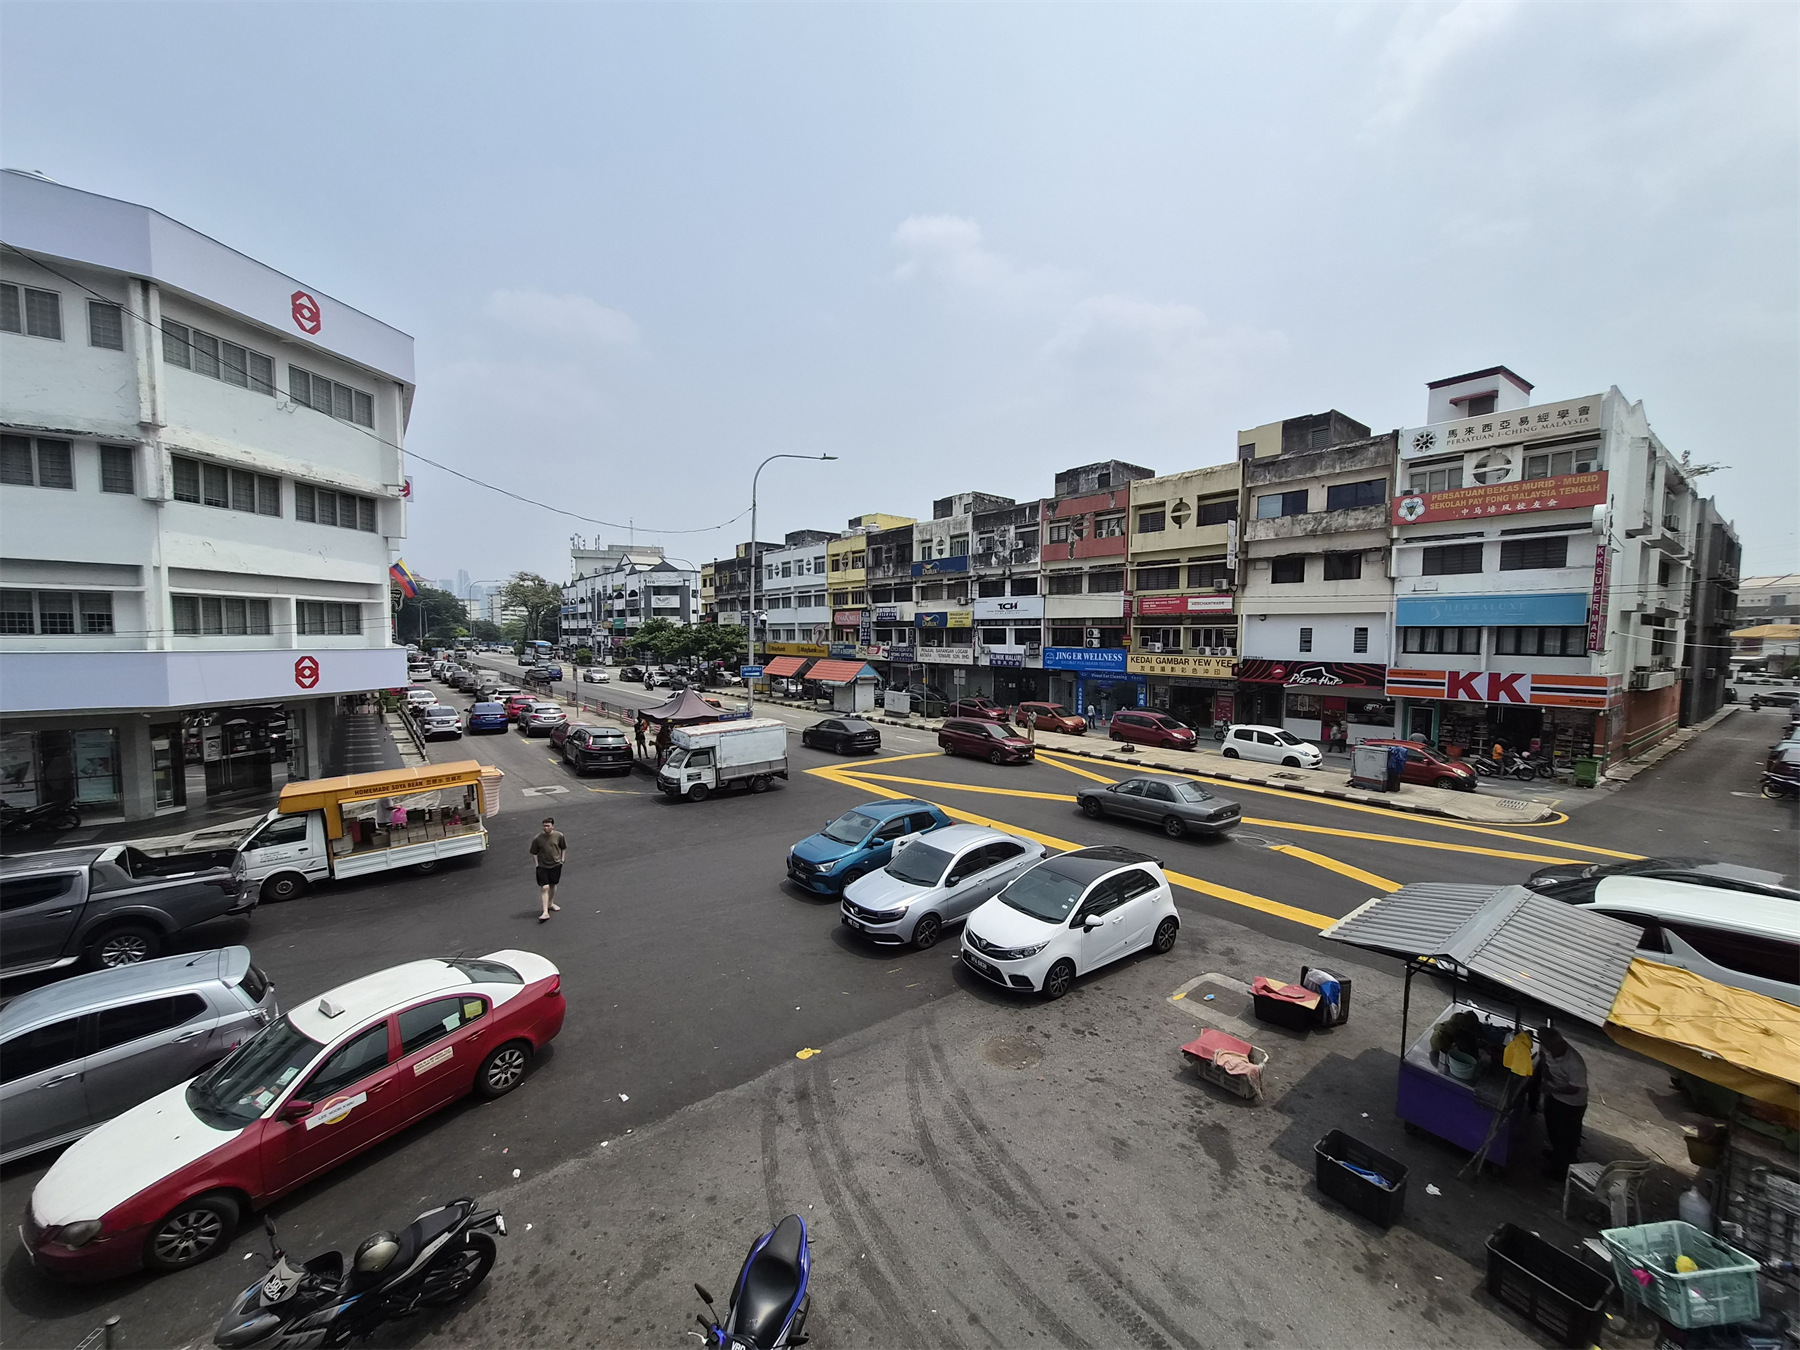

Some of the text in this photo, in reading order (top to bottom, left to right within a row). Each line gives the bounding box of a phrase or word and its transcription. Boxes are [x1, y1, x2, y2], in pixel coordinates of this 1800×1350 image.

[1446, 416, 1590, 446] PERSATUAN I-CHING MALAYSIA
[1447, 405, 1591, 440] 馬來西亞易經學會
[1430, 483, 1600, 510] SEKOLAH PAY FONG MALAYSIA TENGAH
[1431, 488, 1485, 501] PERSATUAN
[1486, 483, 1519, 495] BEKAS
[1522, 479, 1555, 490] MURID
[1563, 474, 1599, 486] MURID
[1055, 651, 1123, 662] JING ER WELLNESS
[1130, 656, 1233, 668] KEDAI GAMBAR YEW YEE
[1289, 673, 1344, 686] Pizza Hut
[1447, 671, 1527, 704] KK
[354, 785, 390, 796] HOMEMADE
[407, 780, 423, 788] BEAN
